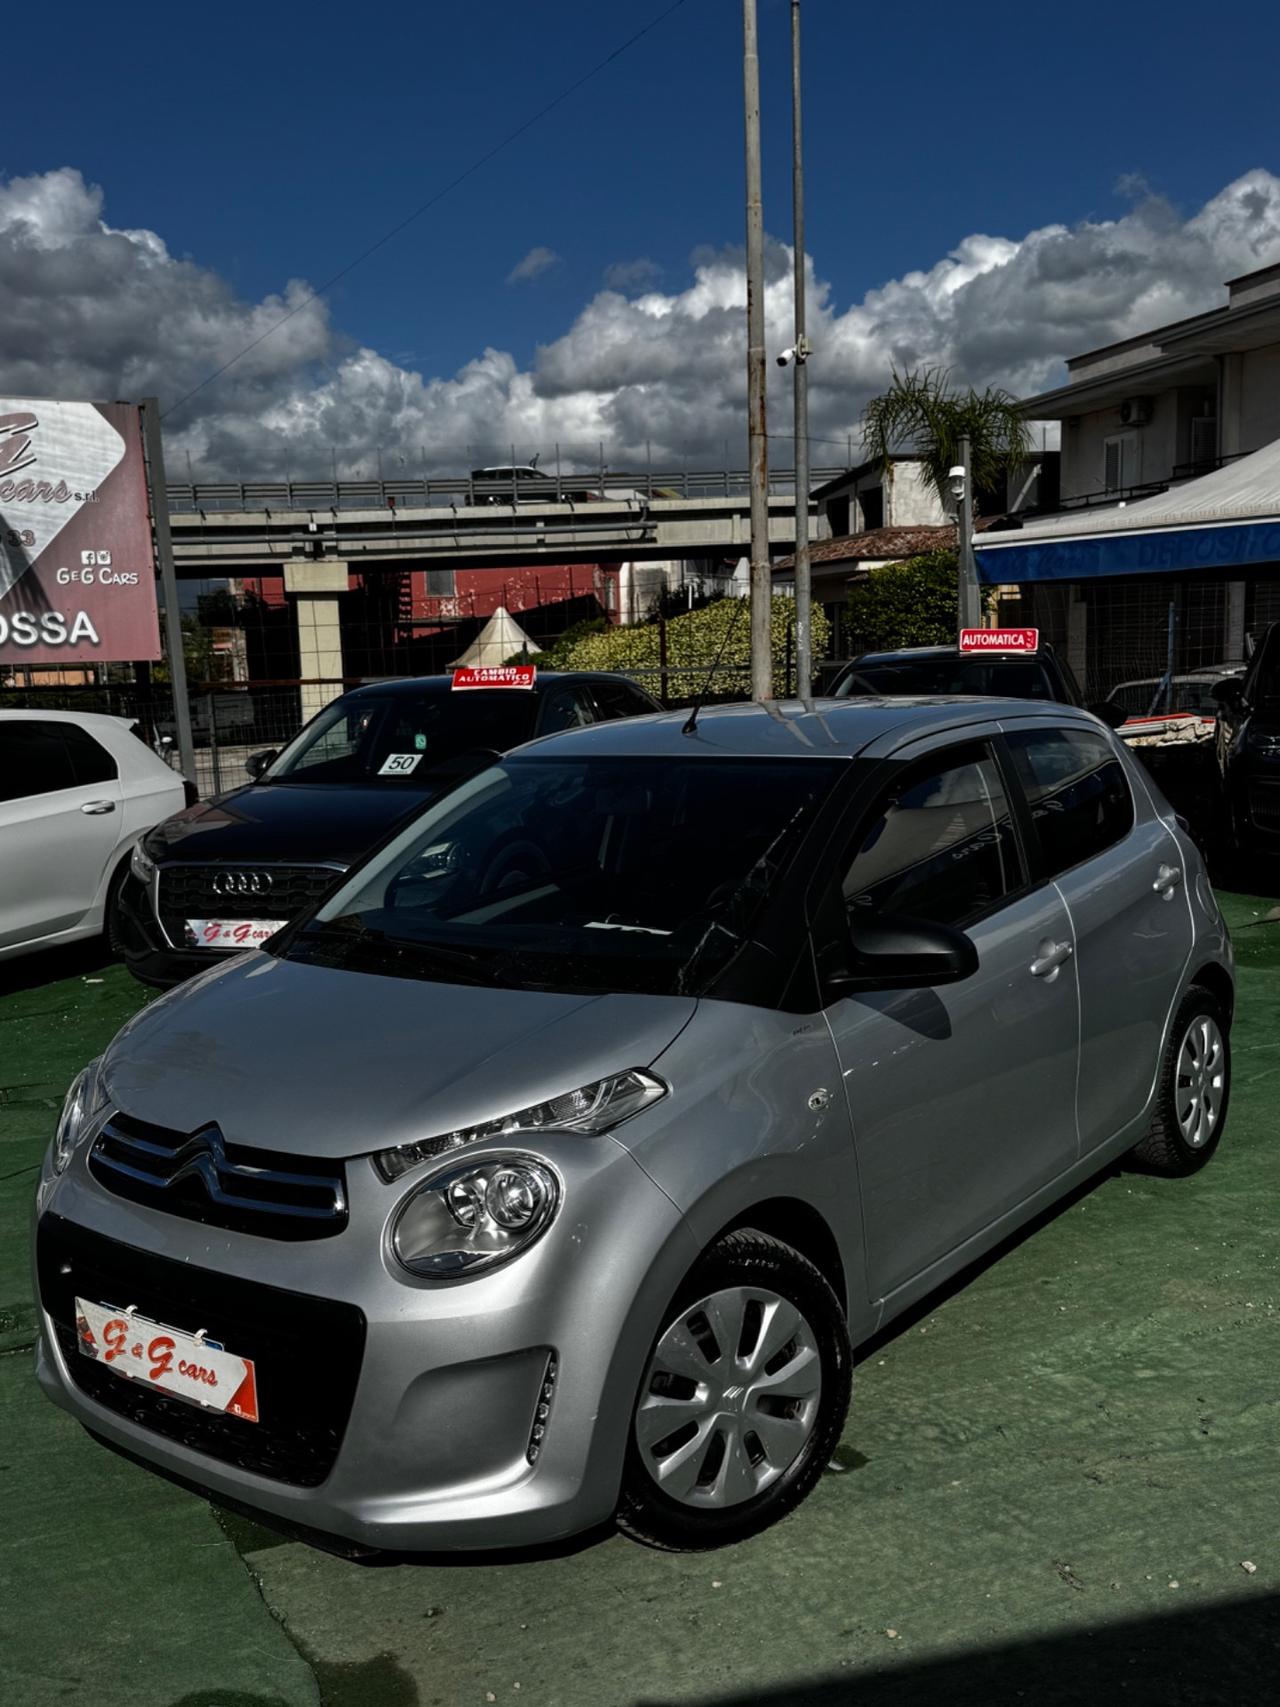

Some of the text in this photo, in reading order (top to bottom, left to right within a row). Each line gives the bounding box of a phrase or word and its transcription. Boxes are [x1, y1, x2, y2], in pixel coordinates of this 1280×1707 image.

[963, 634, 1025, 646] AUTOMATICA
[459, 673, 530, 683] AUTOMATICO
[474, 667, 517, 677] CAMBIO
[389, 756, 415, 770] 50
[178, 1359, 218, 1387] cars
